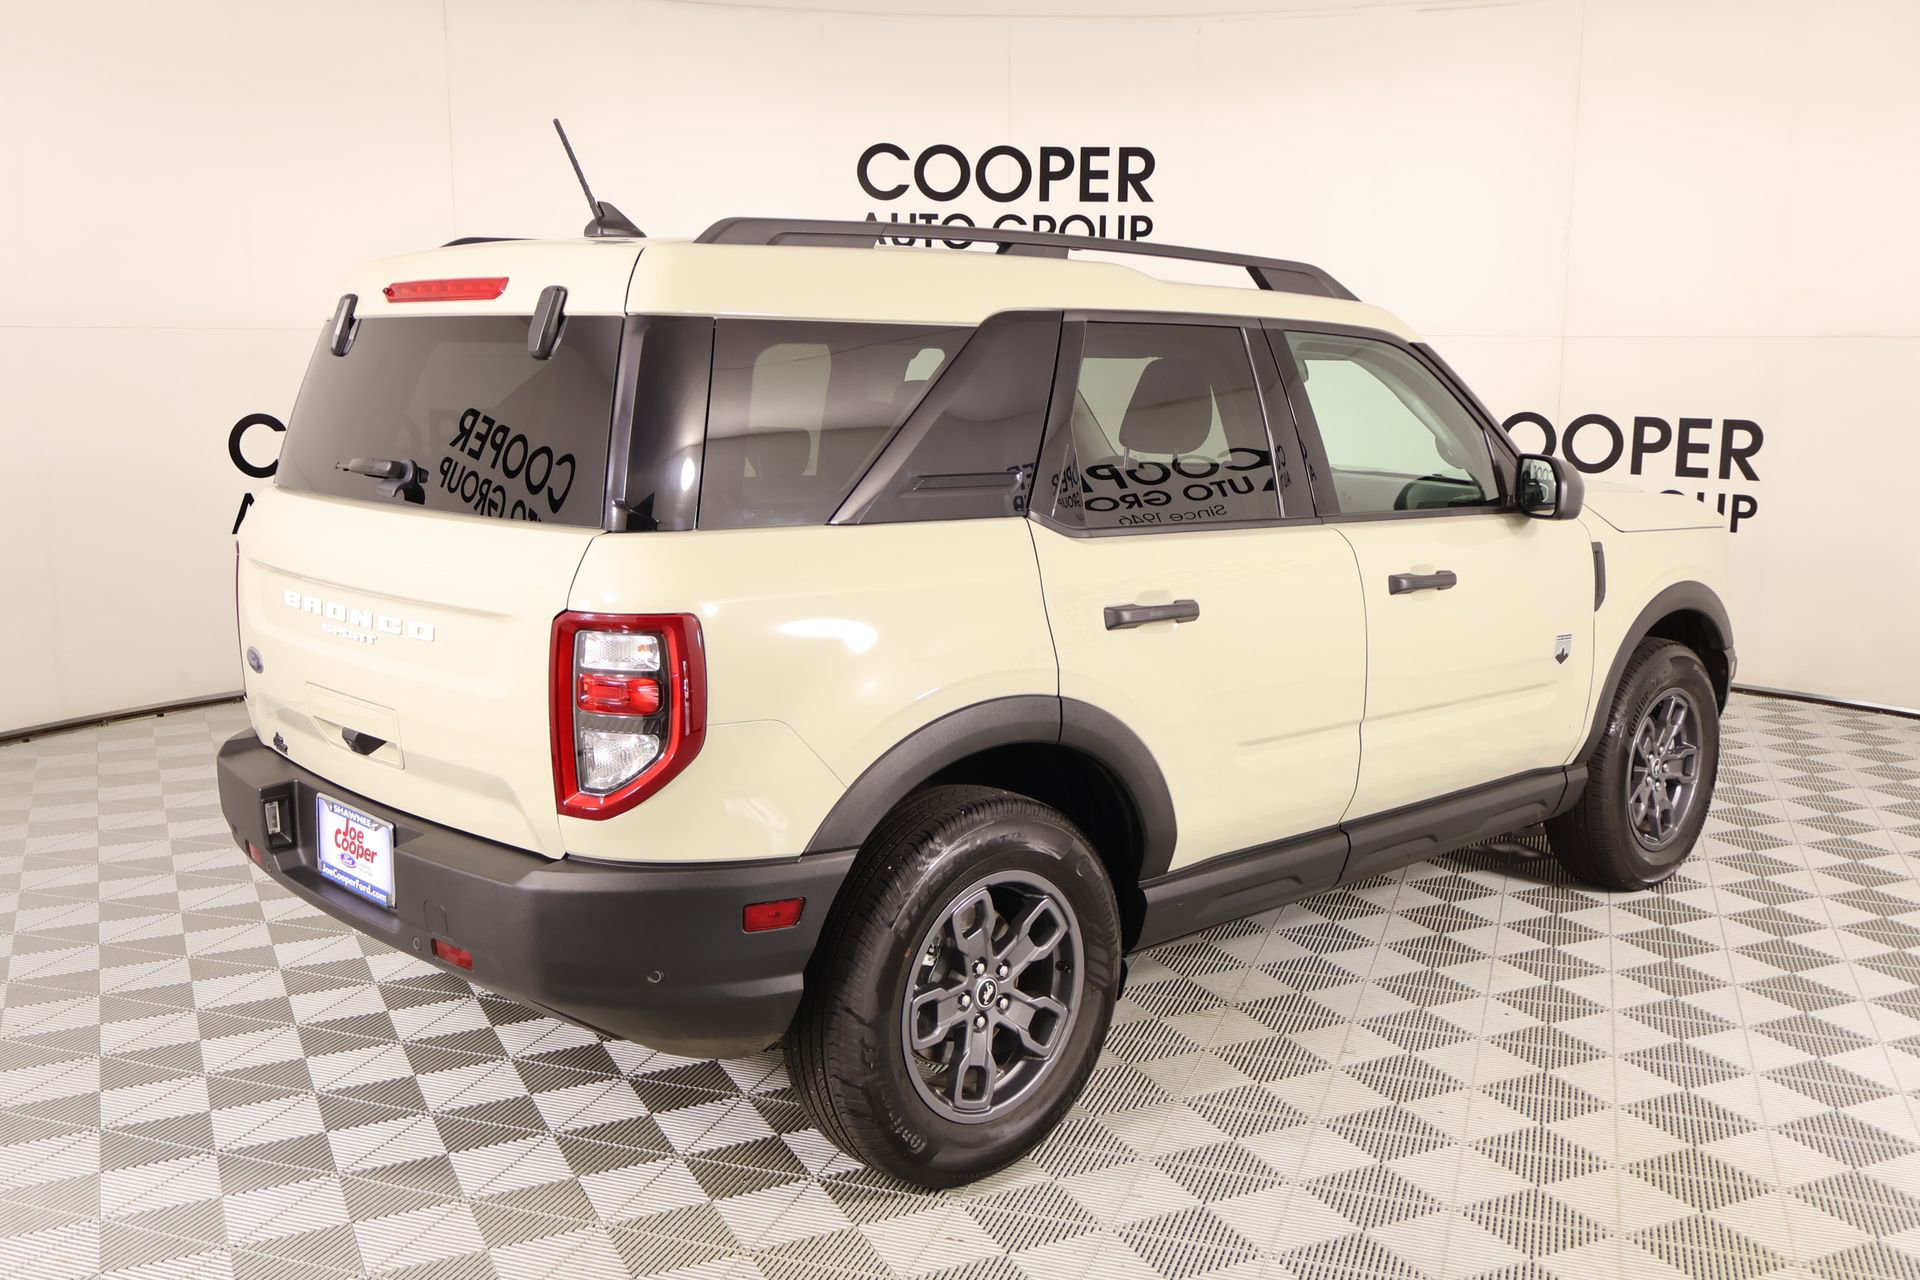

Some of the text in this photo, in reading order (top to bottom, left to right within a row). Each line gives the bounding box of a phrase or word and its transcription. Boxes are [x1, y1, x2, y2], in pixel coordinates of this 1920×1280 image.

[857, 142, 1156, 203] COOPER
[1501, 411, 1764, 482] OOPER
[283, 590, 436, 643] BRONCO
[321, 623, 378, 645] SPORT
[333, 804, 372, 828] SHAWNEE
[342, 817, 364, 844] Joe
[334, 828, 378, 864] Cooper
